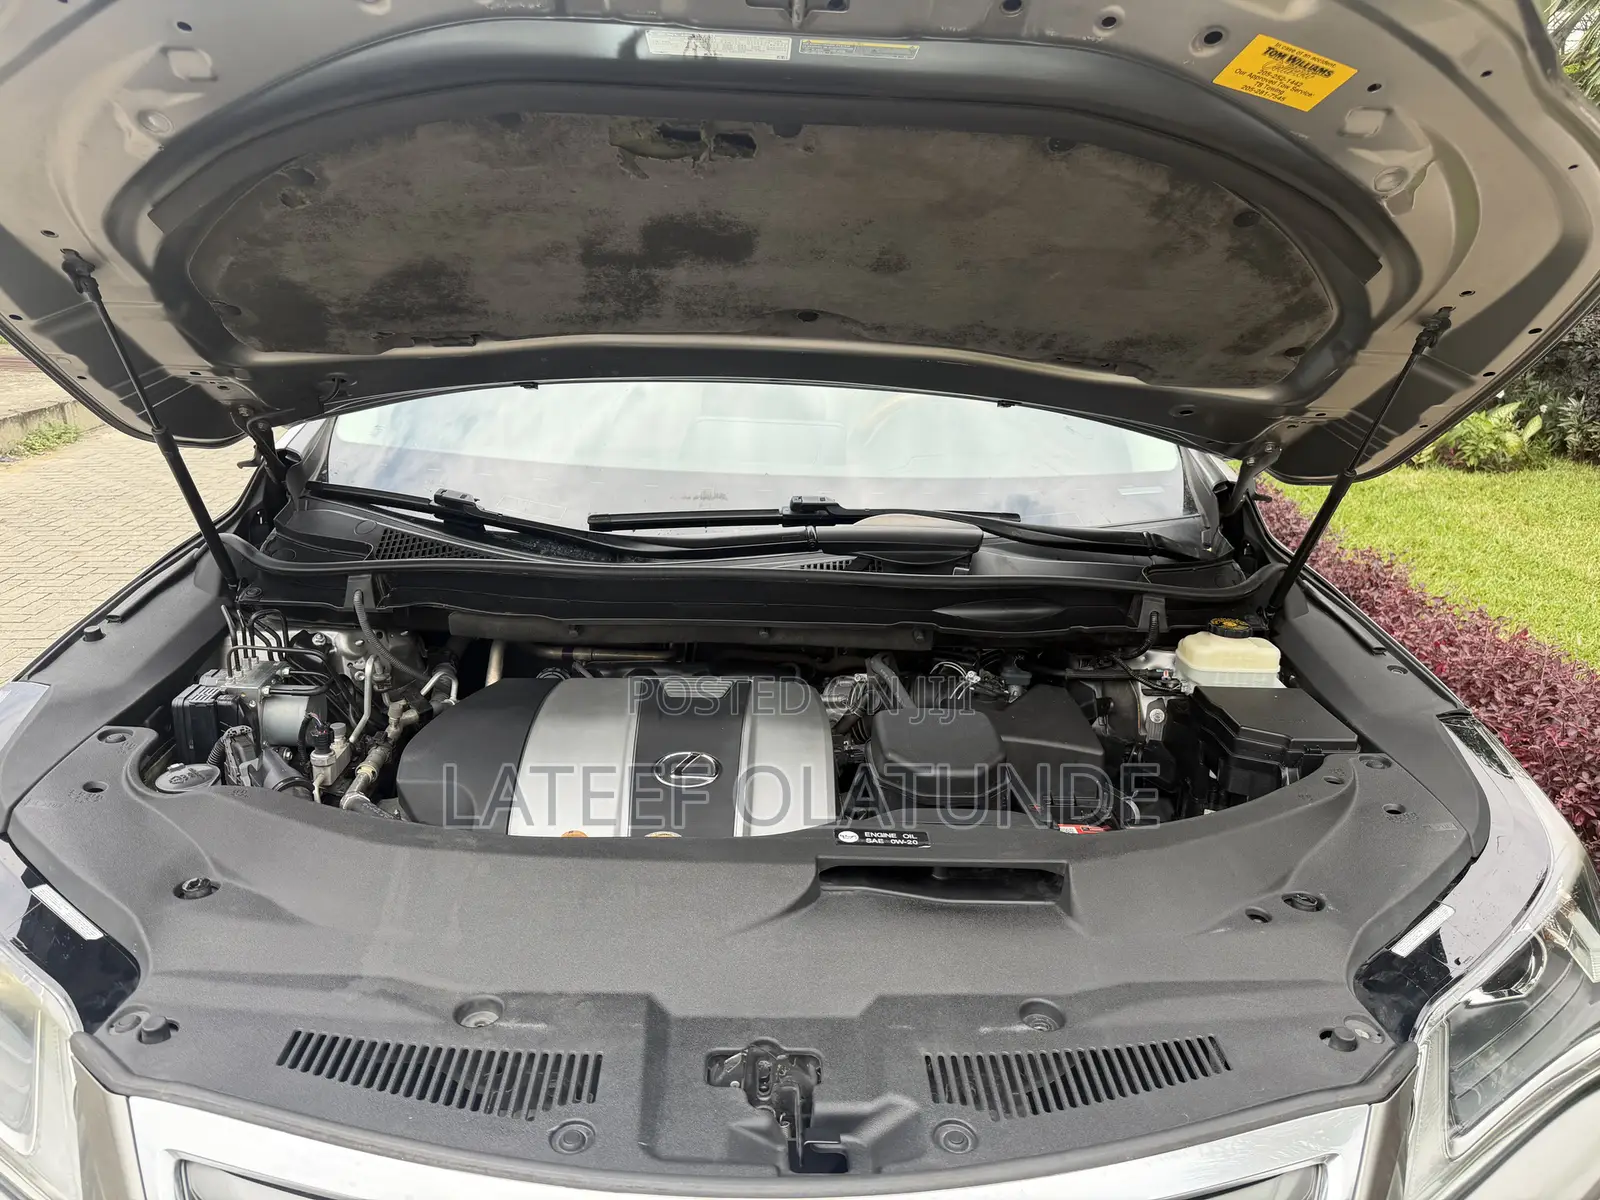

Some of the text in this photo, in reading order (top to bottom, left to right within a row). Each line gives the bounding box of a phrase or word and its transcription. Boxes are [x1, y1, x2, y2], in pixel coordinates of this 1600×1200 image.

[1262, 46, 1334, 78] TOM WILLIAMS
[1248, 72, 1278, 86] Approved
[1264, 84, 1286, 96] Towing
[864, 831, 897, 839] ENGINE
